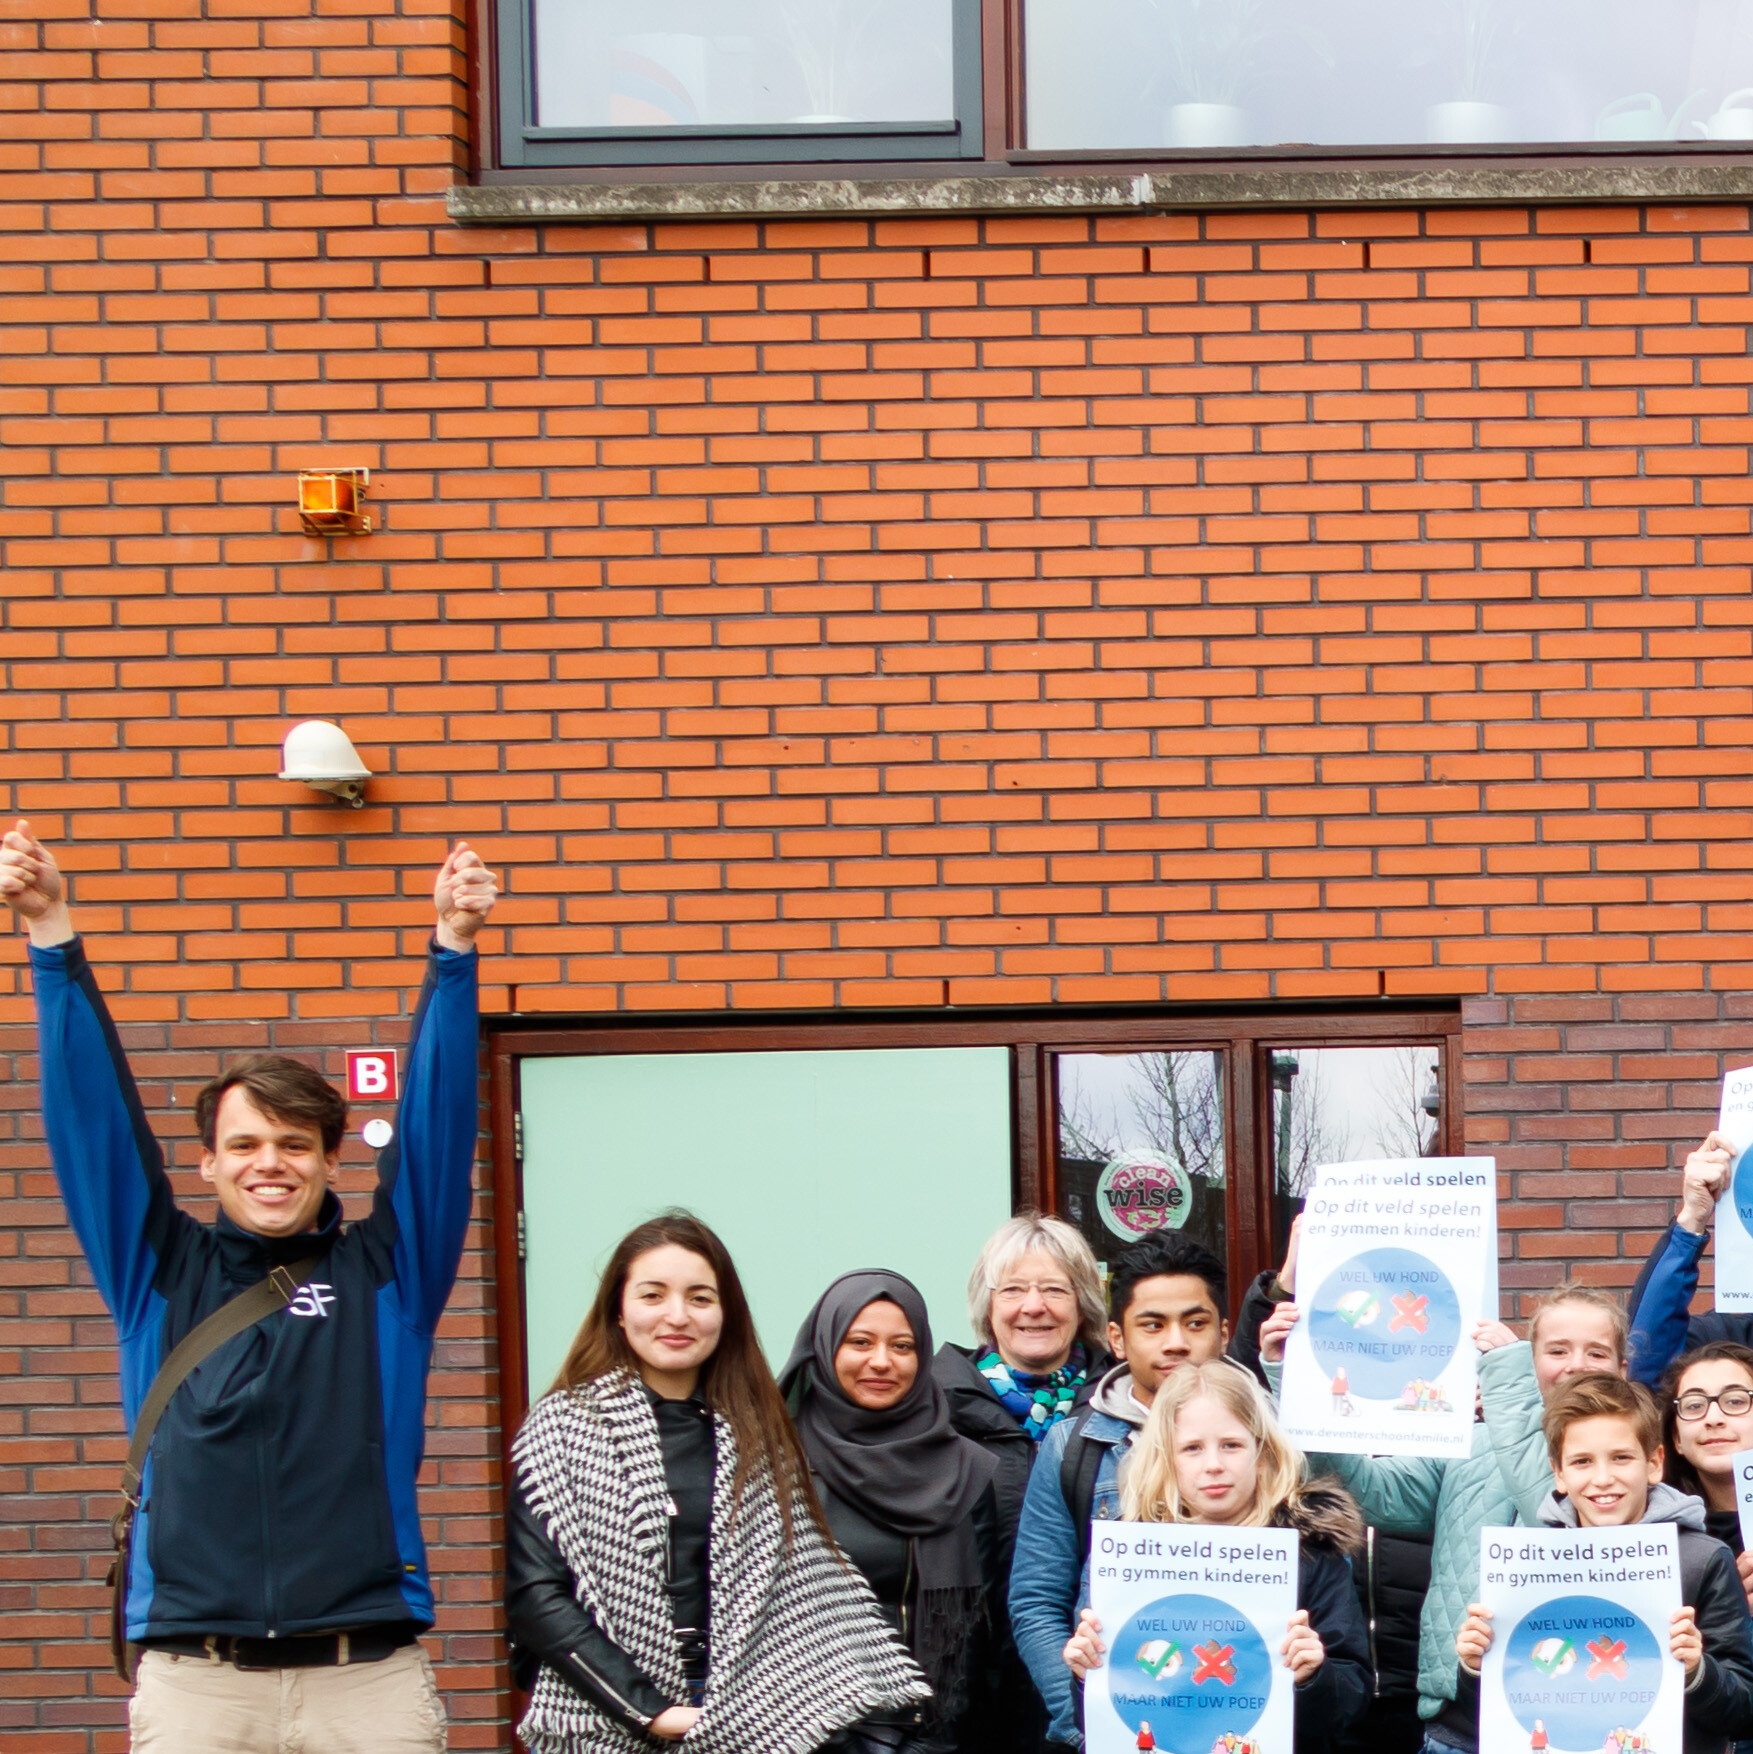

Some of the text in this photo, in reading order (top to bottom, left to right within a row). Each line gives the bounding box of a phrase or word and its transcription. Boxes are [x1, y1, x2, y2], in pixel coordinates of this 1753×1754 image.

[355, 1057, 389, 1094] B
[1118, 1167, 1172, 1188] clean
[1103, 1180, 1184, 1208] wise
[1100, 1537, 1287, 1564] Op dit veld spelen
[1488, 1540, 1668, 1564] Op dit veld spelen
[1098, 1566, 1288, 1585] en gymmen kinderen!
[1486, 1565, 1671, 1587] en gymmen kinderen!
[1136, 1618, 1246, 1632] WEL UW HOND
[1112, 1692, 1266, 1710] MAAR NIET UW POEP
